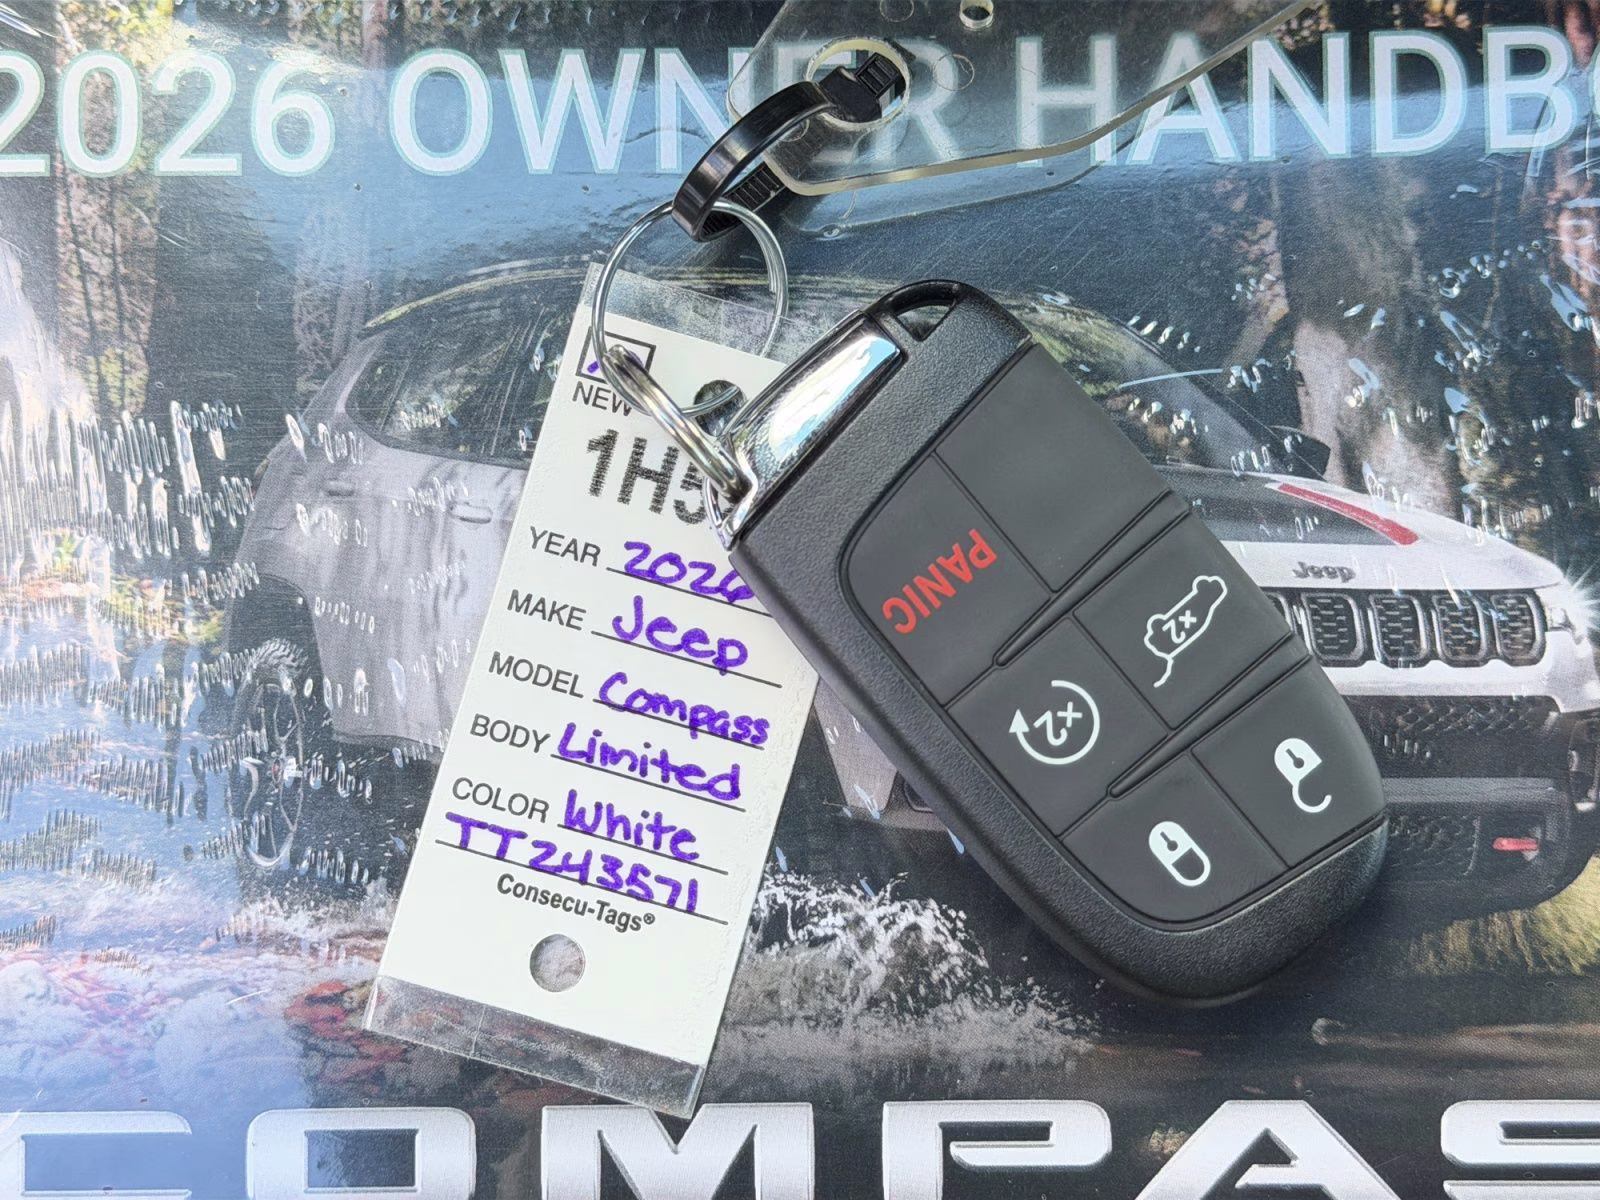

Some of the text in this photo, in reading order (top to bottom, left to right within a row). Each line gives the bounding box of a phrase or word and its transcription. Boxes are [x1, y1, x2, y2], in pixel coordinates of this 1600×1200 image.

[0, 48, 336, 178] 2026
[1014, 24, 1600, 168] HANDB
[572, 381, 633, 417] NEW
[587, 428, 736, 526] 1H5
[529, 526, 601, 567] YEAR
[624, 541, 754, 604] 2026
[1292, 561, 1356, 583] Jeep
[507, 589, 587, 631] MAKE
[881, 529, 998, 635] PANIC
[611, 595, 749, 676] Jeep
[488, 651, 584, 699] MODEL
[598, 671, 770, 746] Compass
[469, 713, 551, 754] BODY
[557, 722, 741, 801] Limited
[452, 777, 550, 824] COLOR
[563, 789, 701, 862] White
[445, 811, 700, 914] TT243571
